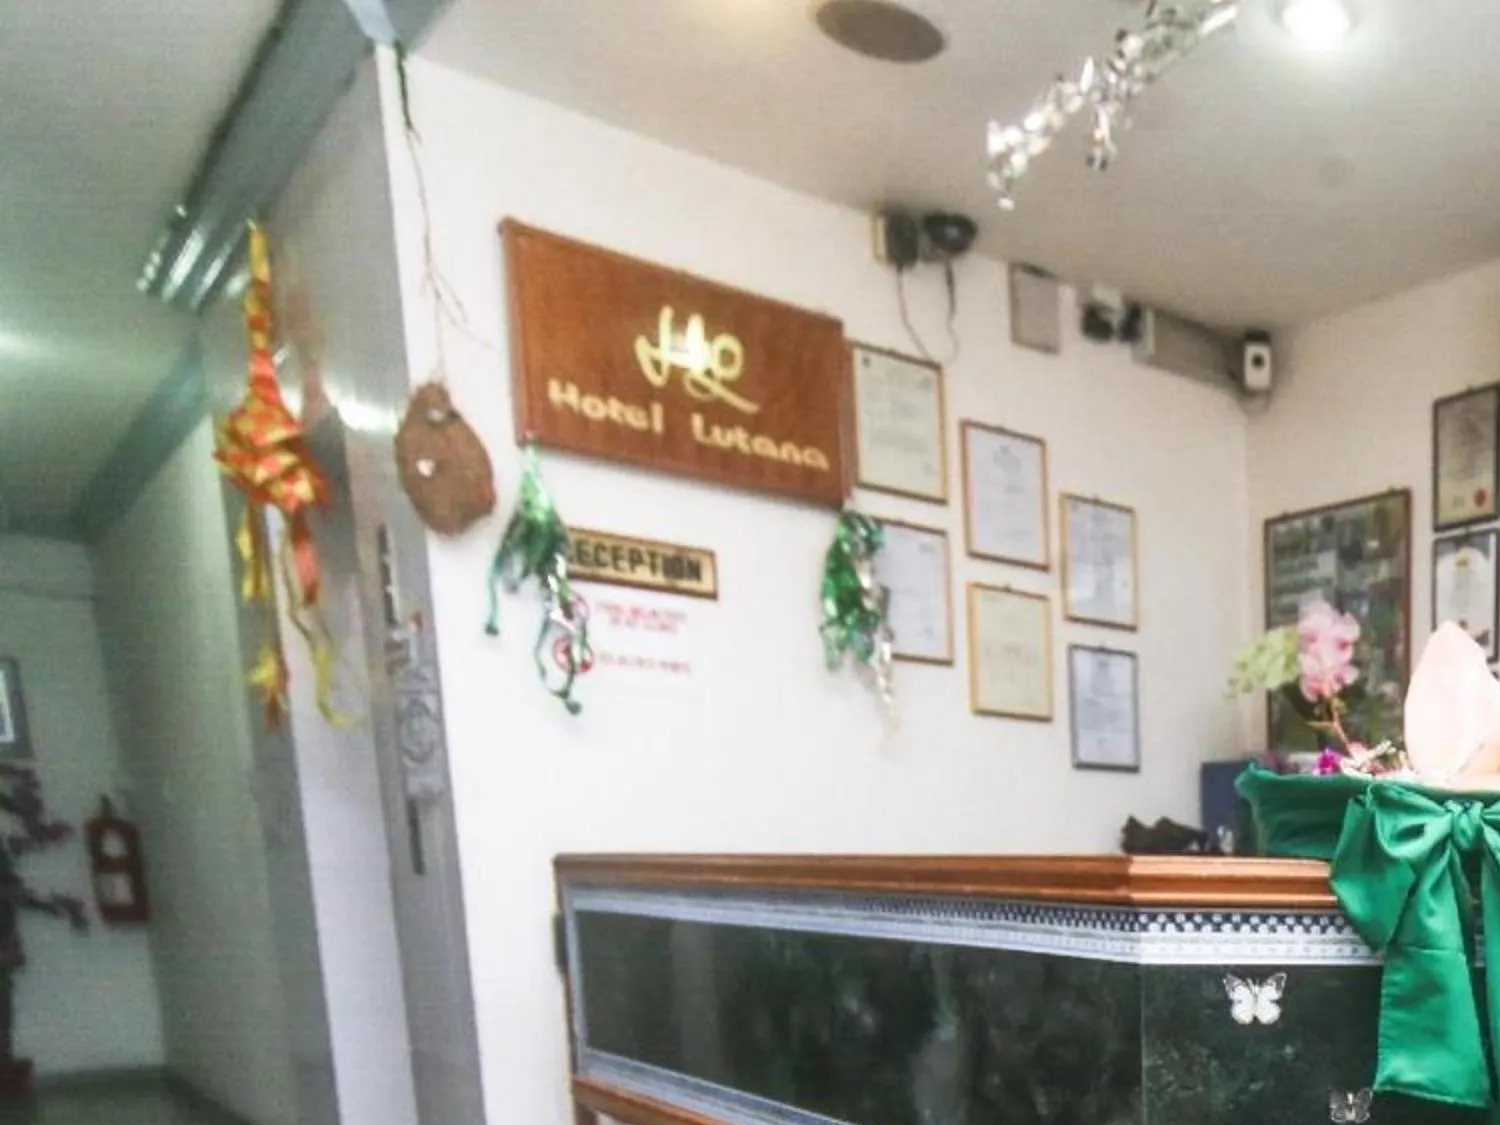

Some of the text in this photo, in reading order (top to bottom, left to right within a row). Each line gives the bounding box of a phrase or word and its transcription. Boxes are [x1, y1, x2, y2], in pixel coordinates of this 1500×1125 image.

[547, 377, 664, 435] Hotel
[690, 412, 829, 471] Lutana
[565, 538, 703, 582] ECEPTION
